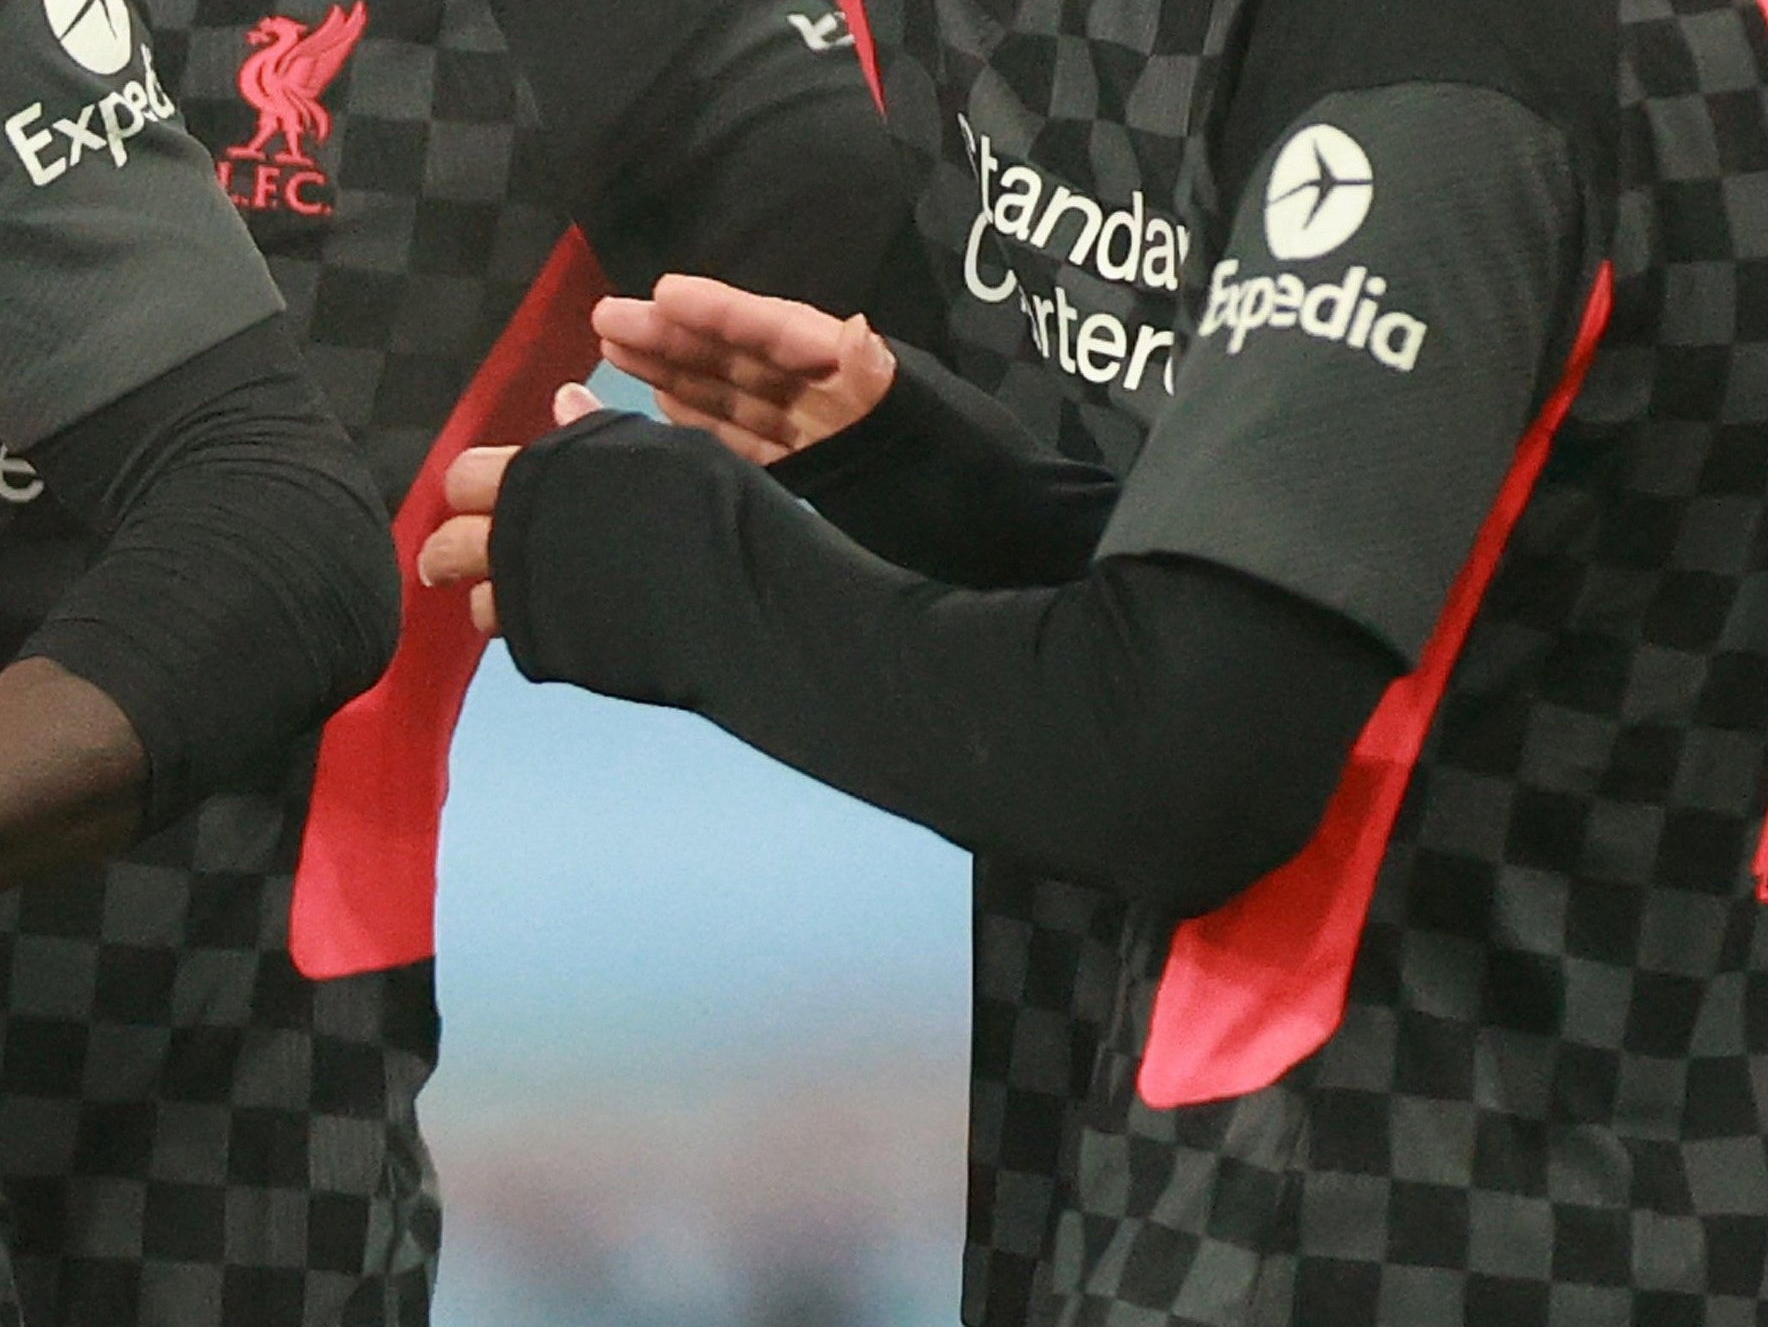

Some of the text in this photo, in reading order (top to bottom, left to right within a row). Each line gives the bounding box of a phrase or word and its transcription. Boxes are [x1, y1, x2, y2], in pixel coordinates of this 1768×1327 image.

[5, 43, 176, 186] Exped
[957, 112, 1191, 291] tanda
[964, 210, 1175, 396] Crter
[1198, 258, 1428, 371] Expedia
